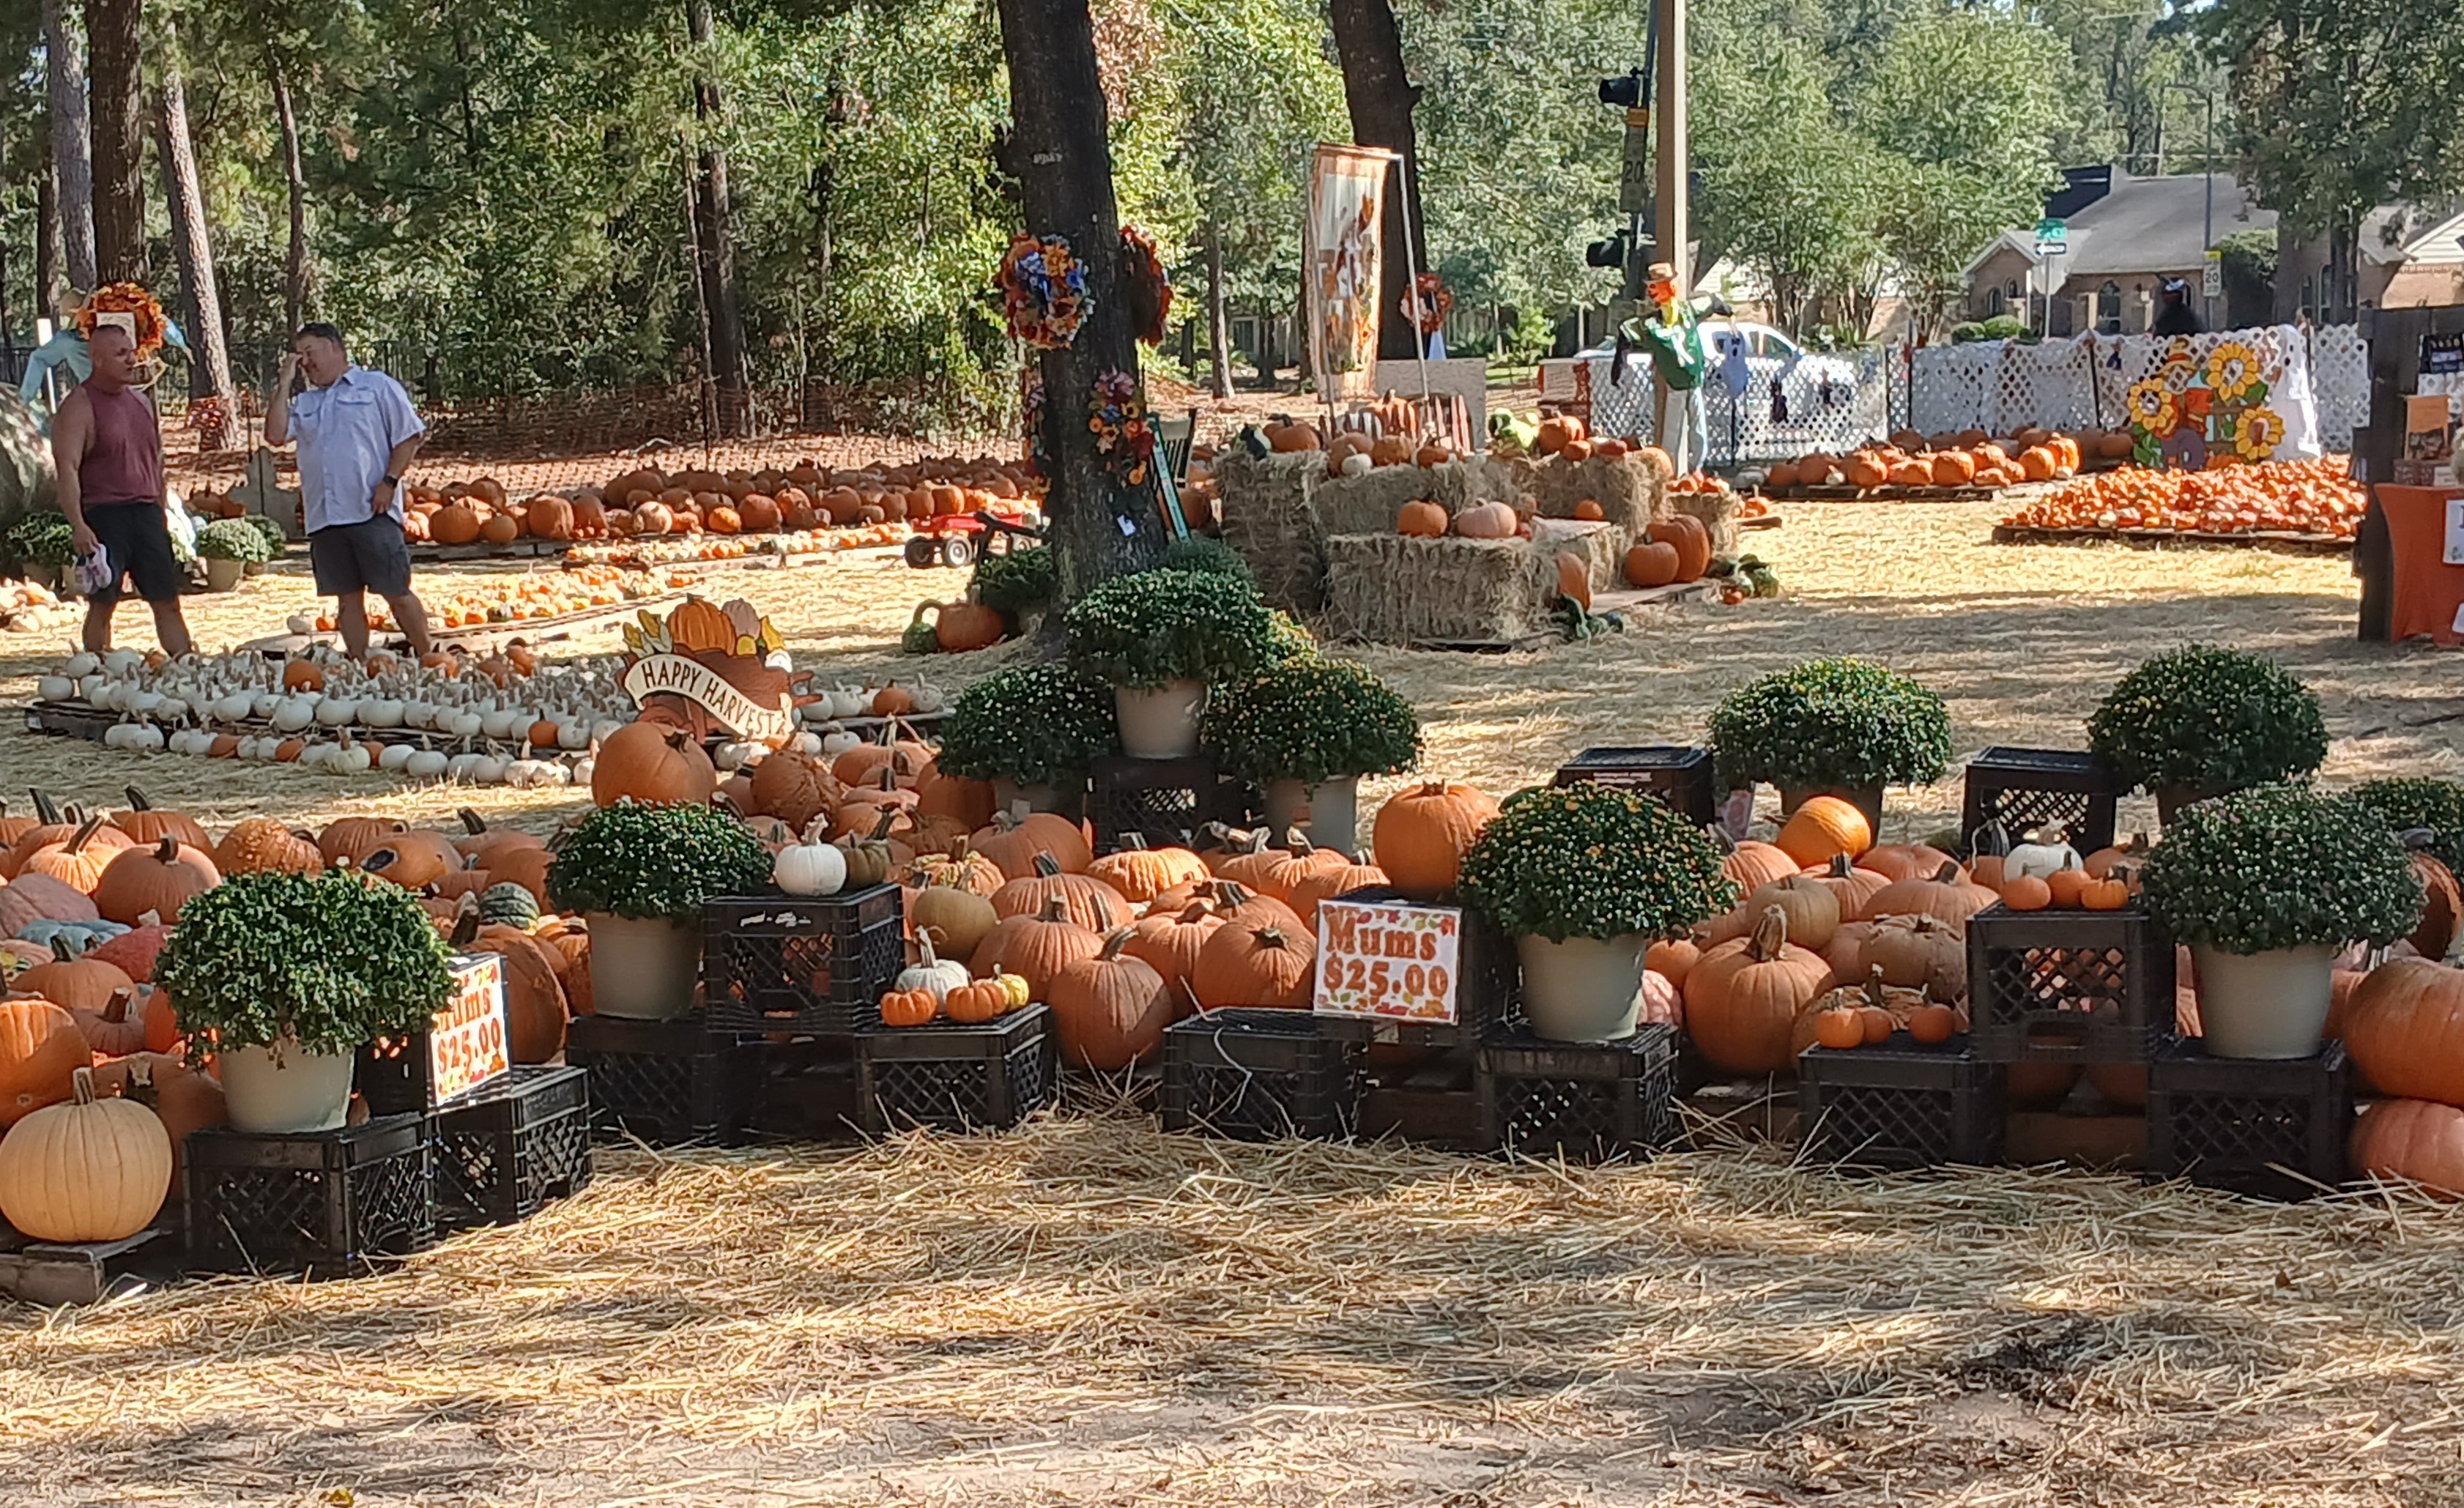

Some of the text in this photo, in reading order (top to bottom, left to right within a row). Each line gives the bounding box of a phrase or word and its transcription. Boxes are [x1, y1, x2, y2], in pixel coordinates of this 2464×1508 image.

[1625, 160, 1641, 183] 20
[2205, 272, 2219, 283] 20
[642, 660, 775, 735] HAPPY HARVEST
[1325, 910, 1437, 961] Mums
[1324, 952, 1448, 998] $25.00
[437, 1017, 501, 1075] $25.00
